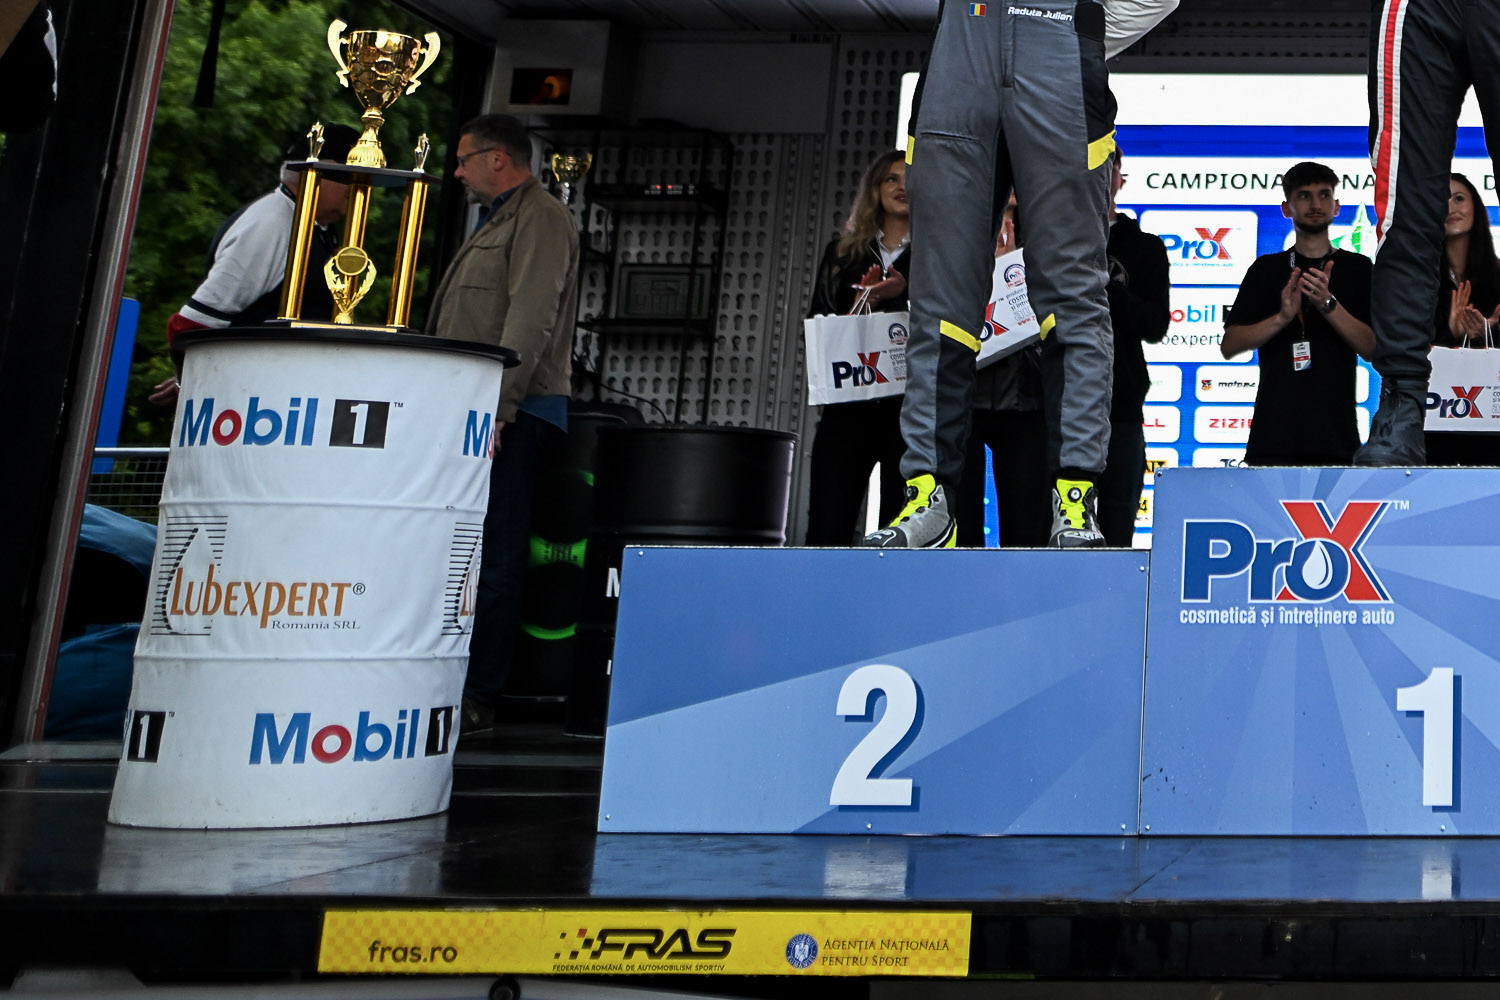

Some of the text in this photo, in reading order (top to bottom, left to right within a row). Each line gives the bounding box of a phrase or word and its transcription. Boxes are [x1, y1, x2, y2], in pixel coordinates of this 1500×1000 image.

[1146, 173, 1284, 190] CAMPIONA
[1008, 293, 1027, 306] cosm
[1169, 304, 1216, 323] obil
[832, 351, 889, 389] ProX
[1424, 386, 1485, 418] ProX
[178, 396, 319, 448] Mobil
[1181, 500, 1395, 604] ProX
[271, 619, 361, 631] Romania SRL
[1180, 606, 1395, 628] cosmetică și întreținere auto
[248, 708, 420, 766] Mobil
[829, 664, 920, 807] 2
[1397, 667, 1456, 808] 1
[368, 940, 458, 964] fras.ro
[590, 928, 737, 960] FRAS
[822, 938, 950, 952] AGENȚIA NAȚIONALĂ
[625, 964, 635, 972] DE
[637, 964, 693, 972] AUTOMOBILISM
[694, 964, 725, 972] SPORTIV
